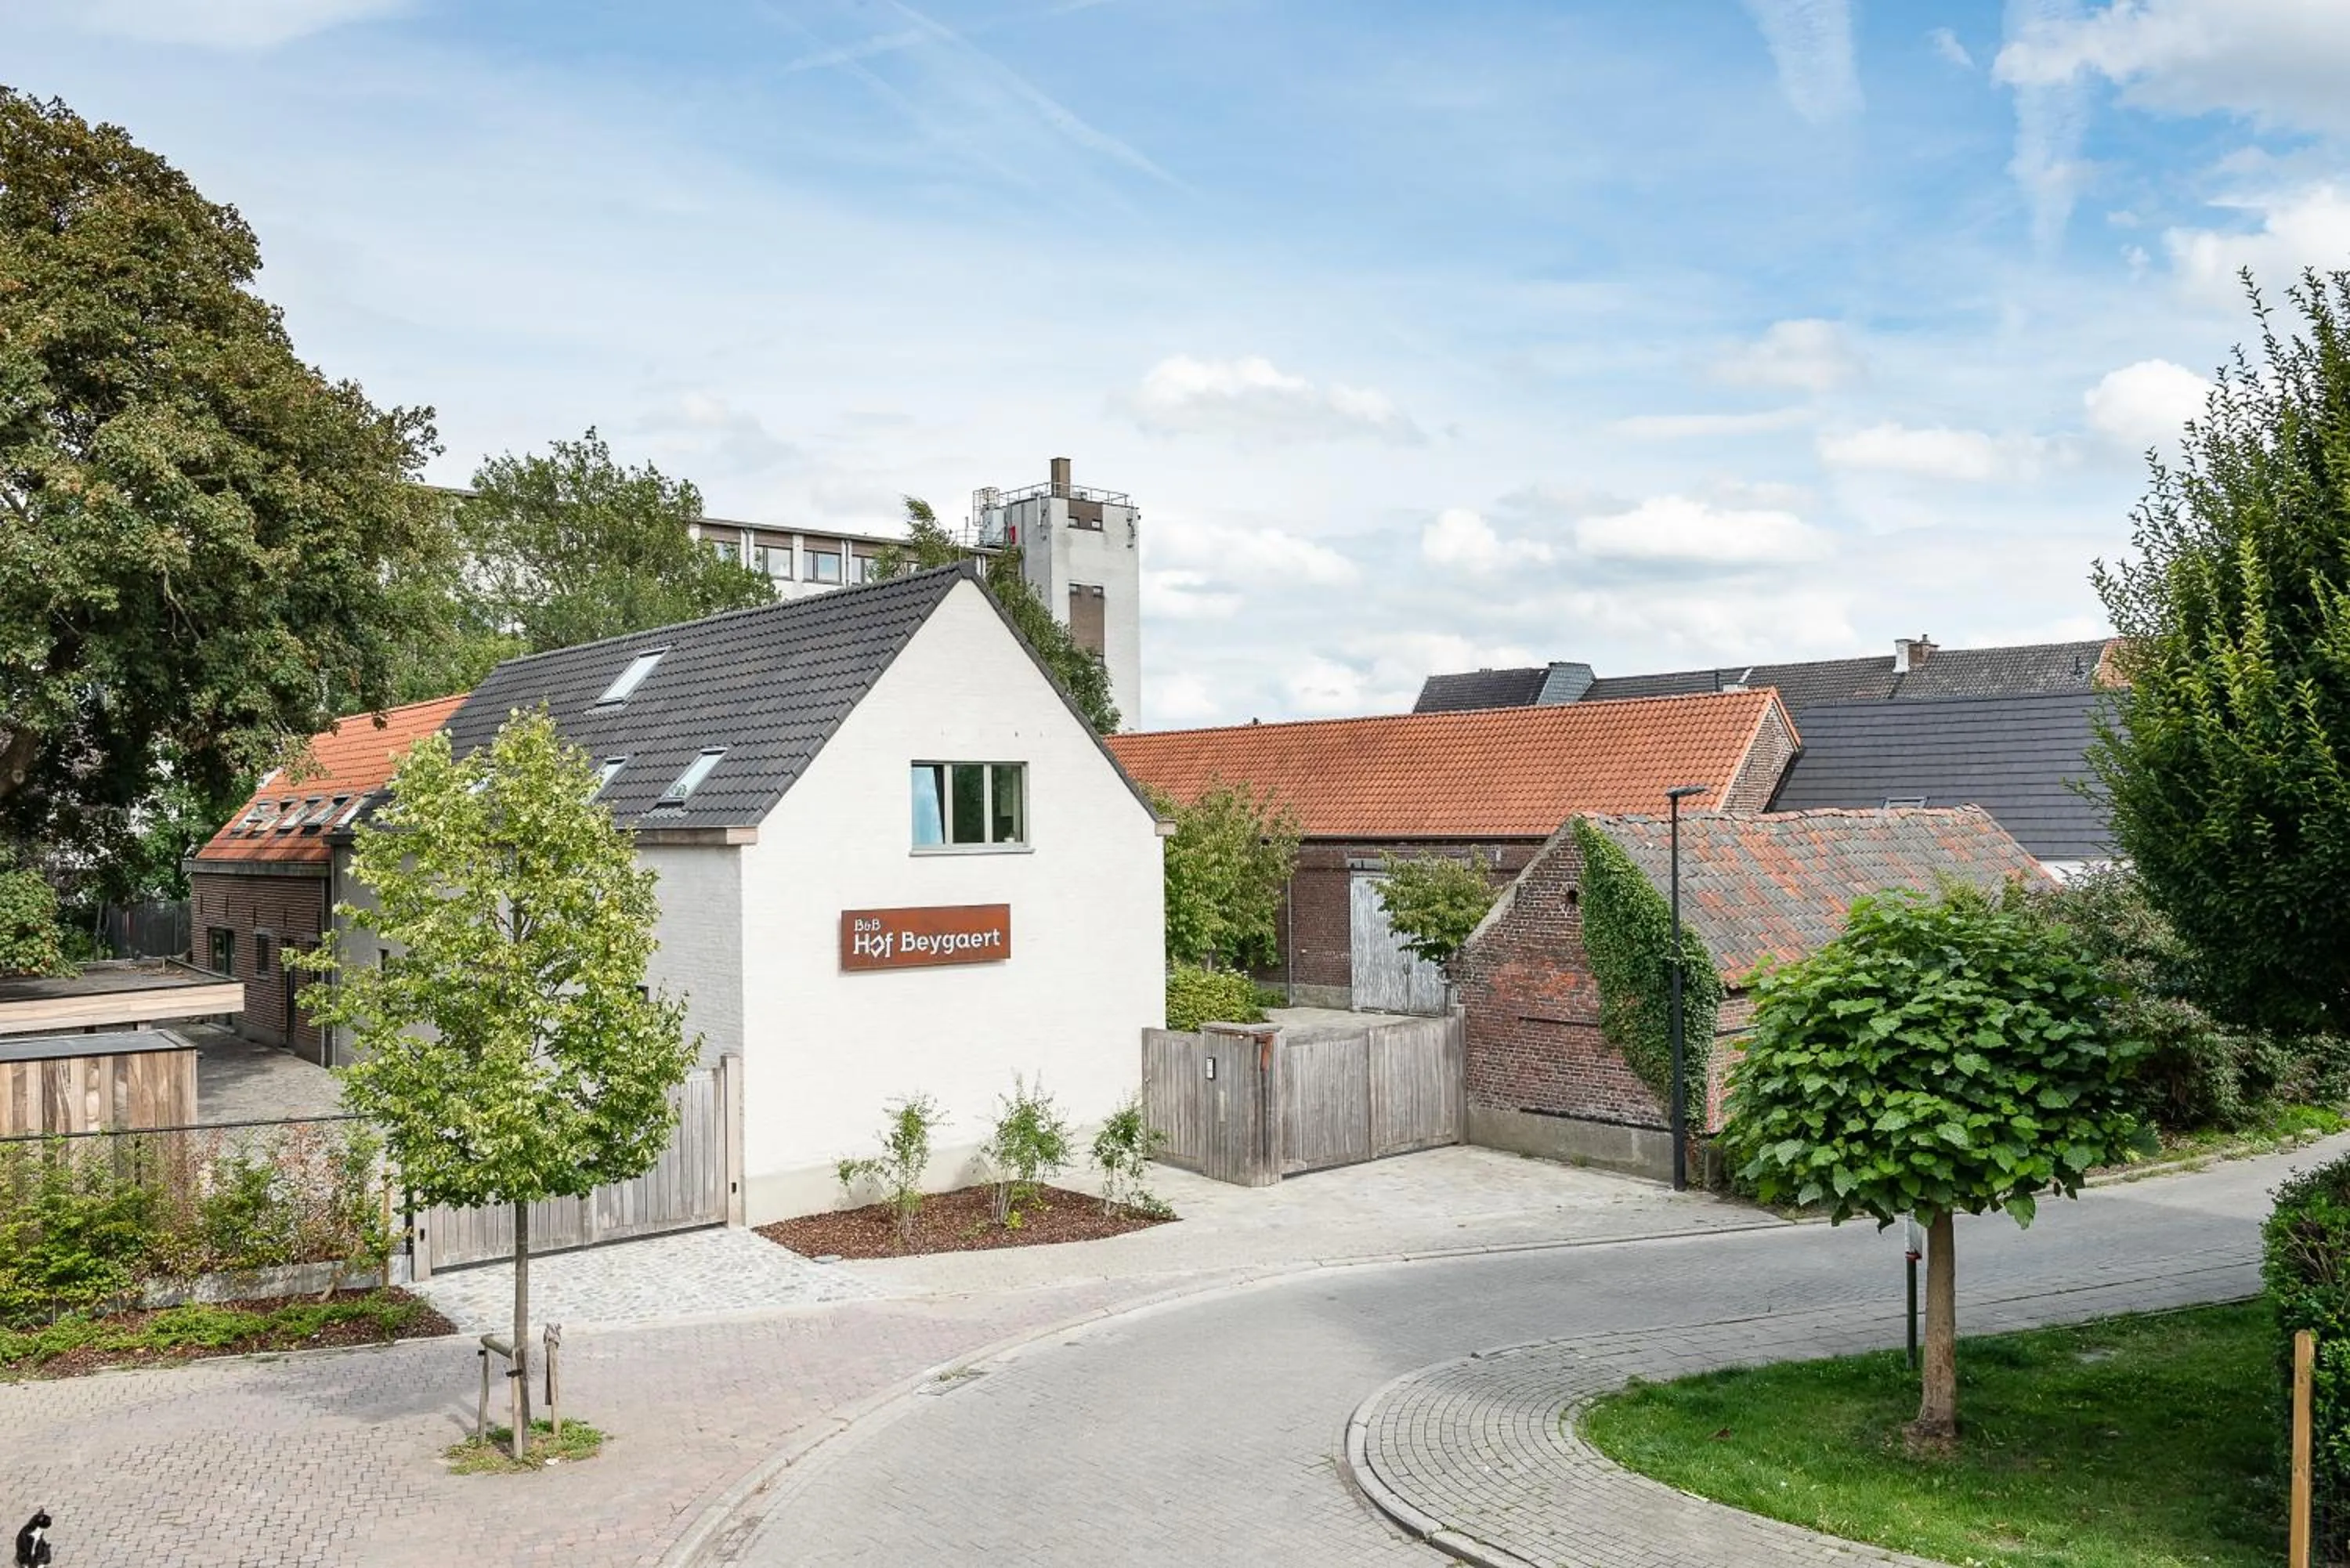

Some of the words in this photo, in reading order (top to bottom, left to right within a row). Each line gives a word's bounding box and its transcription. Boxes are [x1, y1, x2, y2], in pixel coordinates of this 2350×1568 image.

[854, 919, 880, 931] B&B
[853, 933, 893, 958] Hof
[900, 929, 1000, 954] Beygaert
